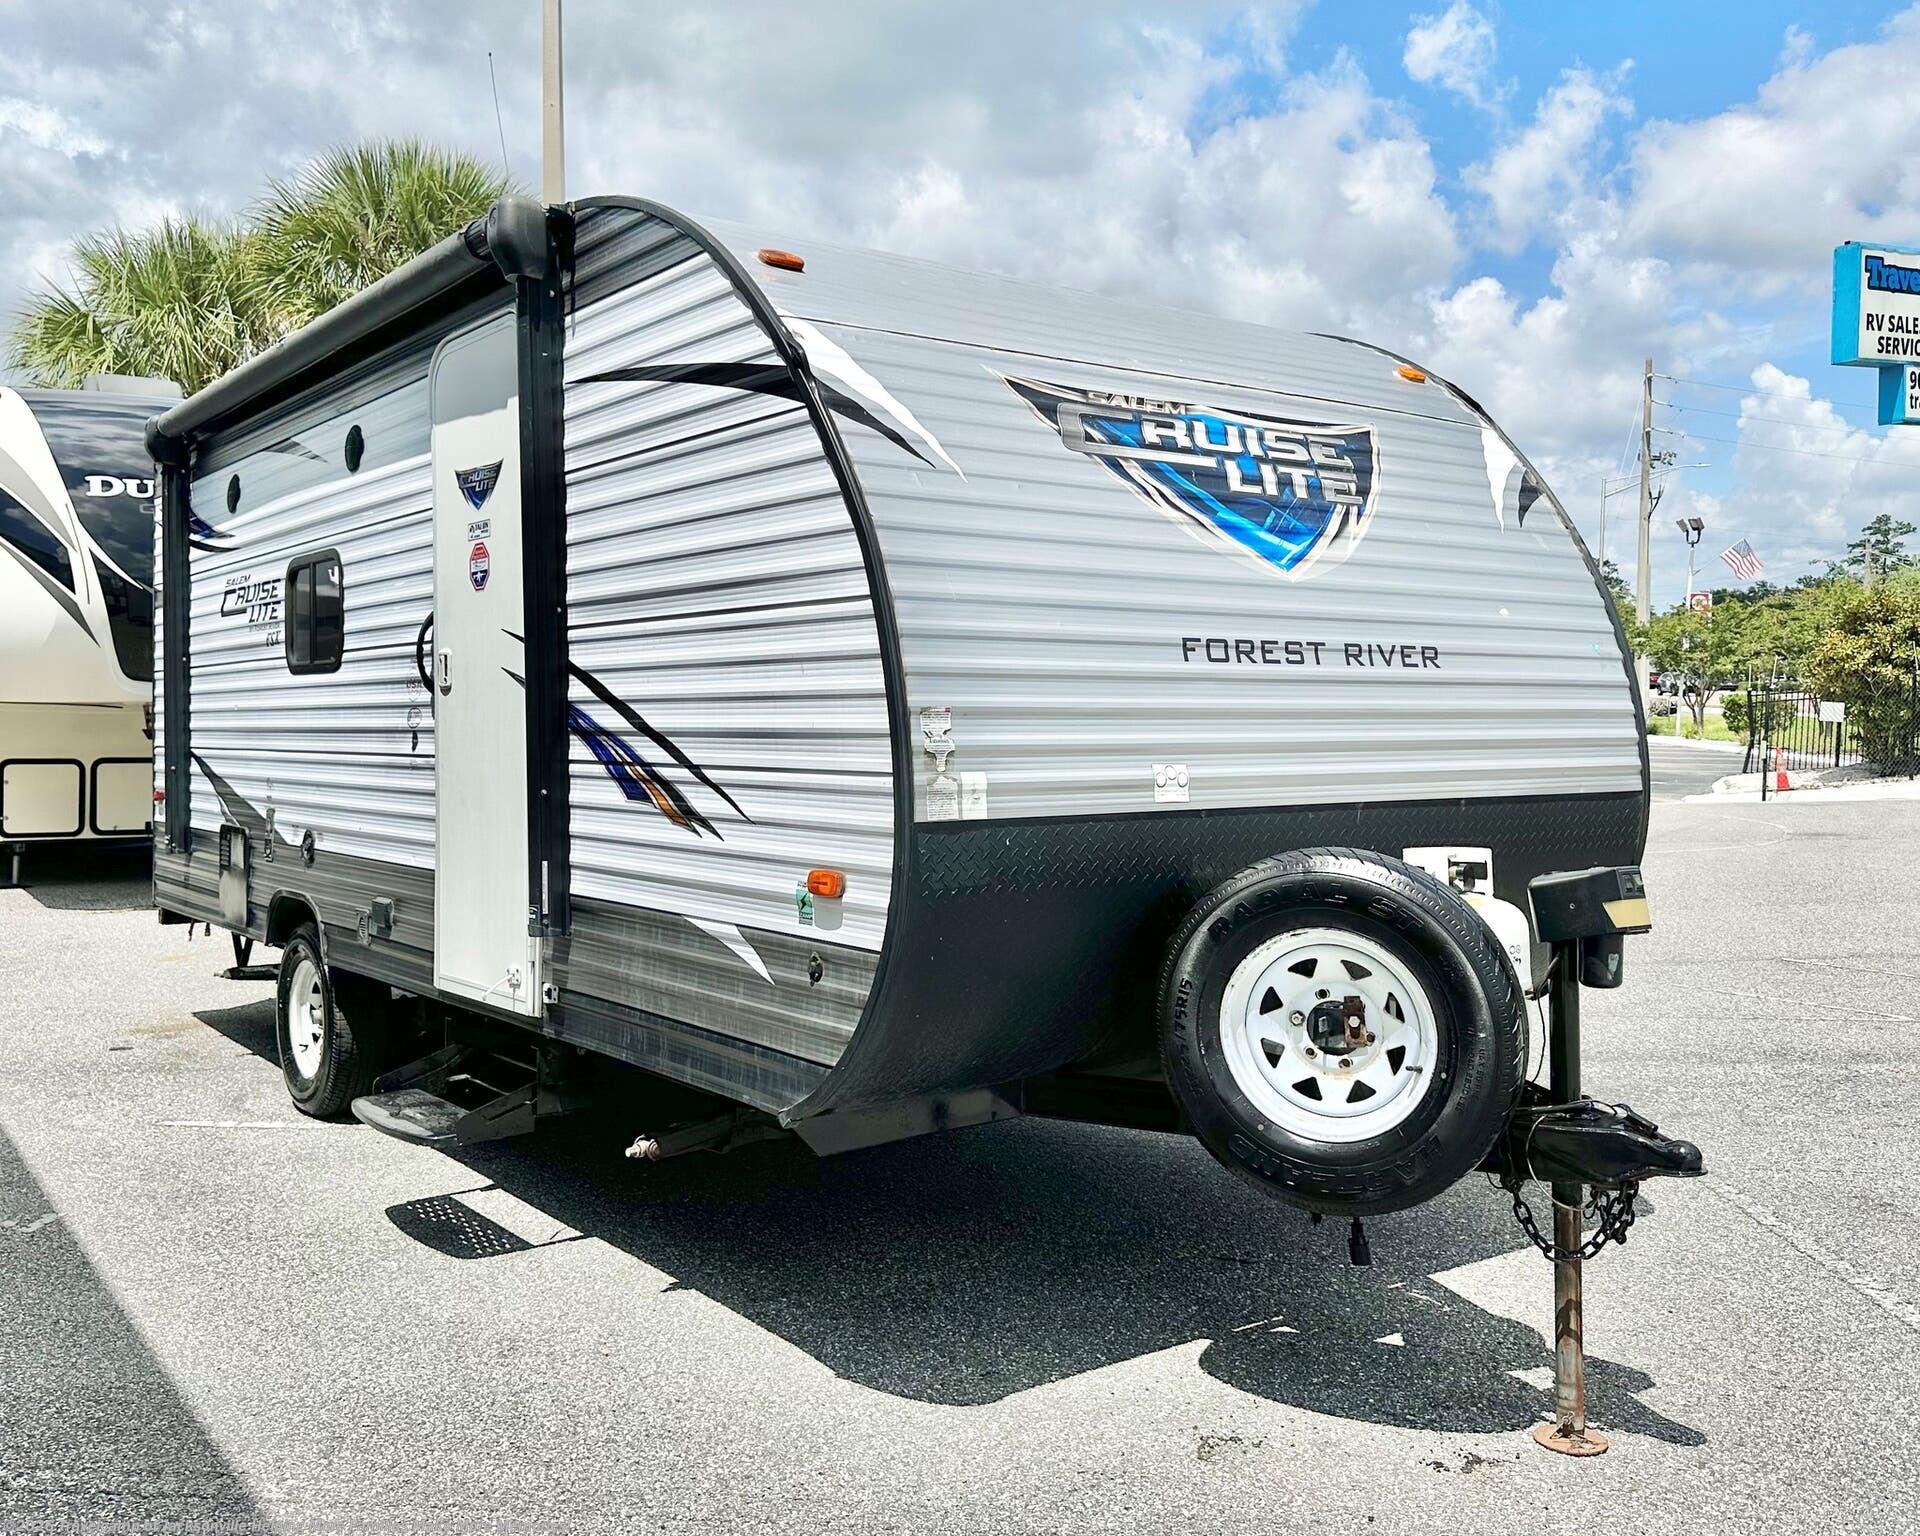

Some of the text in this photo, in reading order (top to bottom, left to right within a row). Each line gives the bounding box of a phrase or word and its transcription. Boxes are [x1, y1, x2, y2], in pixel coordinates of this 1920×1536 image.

[1866, 256, 1920, 293] Trave
[1866, 313, 1920, 334] RV SALE
[1087, 391, 1186, 415] SALEM
[1910, 393, 1920, 410] tr
[1057, 402, 1356, 470] CRUISE
[459, 467, 498, 489] CRUISE
[475, 479, 496, 491] LITE
[1225, 458, 1363, 504] LITE
[225, 574, 251, 588] SALEM
[221, 578, 281, 617] CRUISE
[249, 600, 281, 623] LITE
[1182, 637, 1441, 669] FOREST RIVER
[1207, 882, 1348, 941] RADIAL
